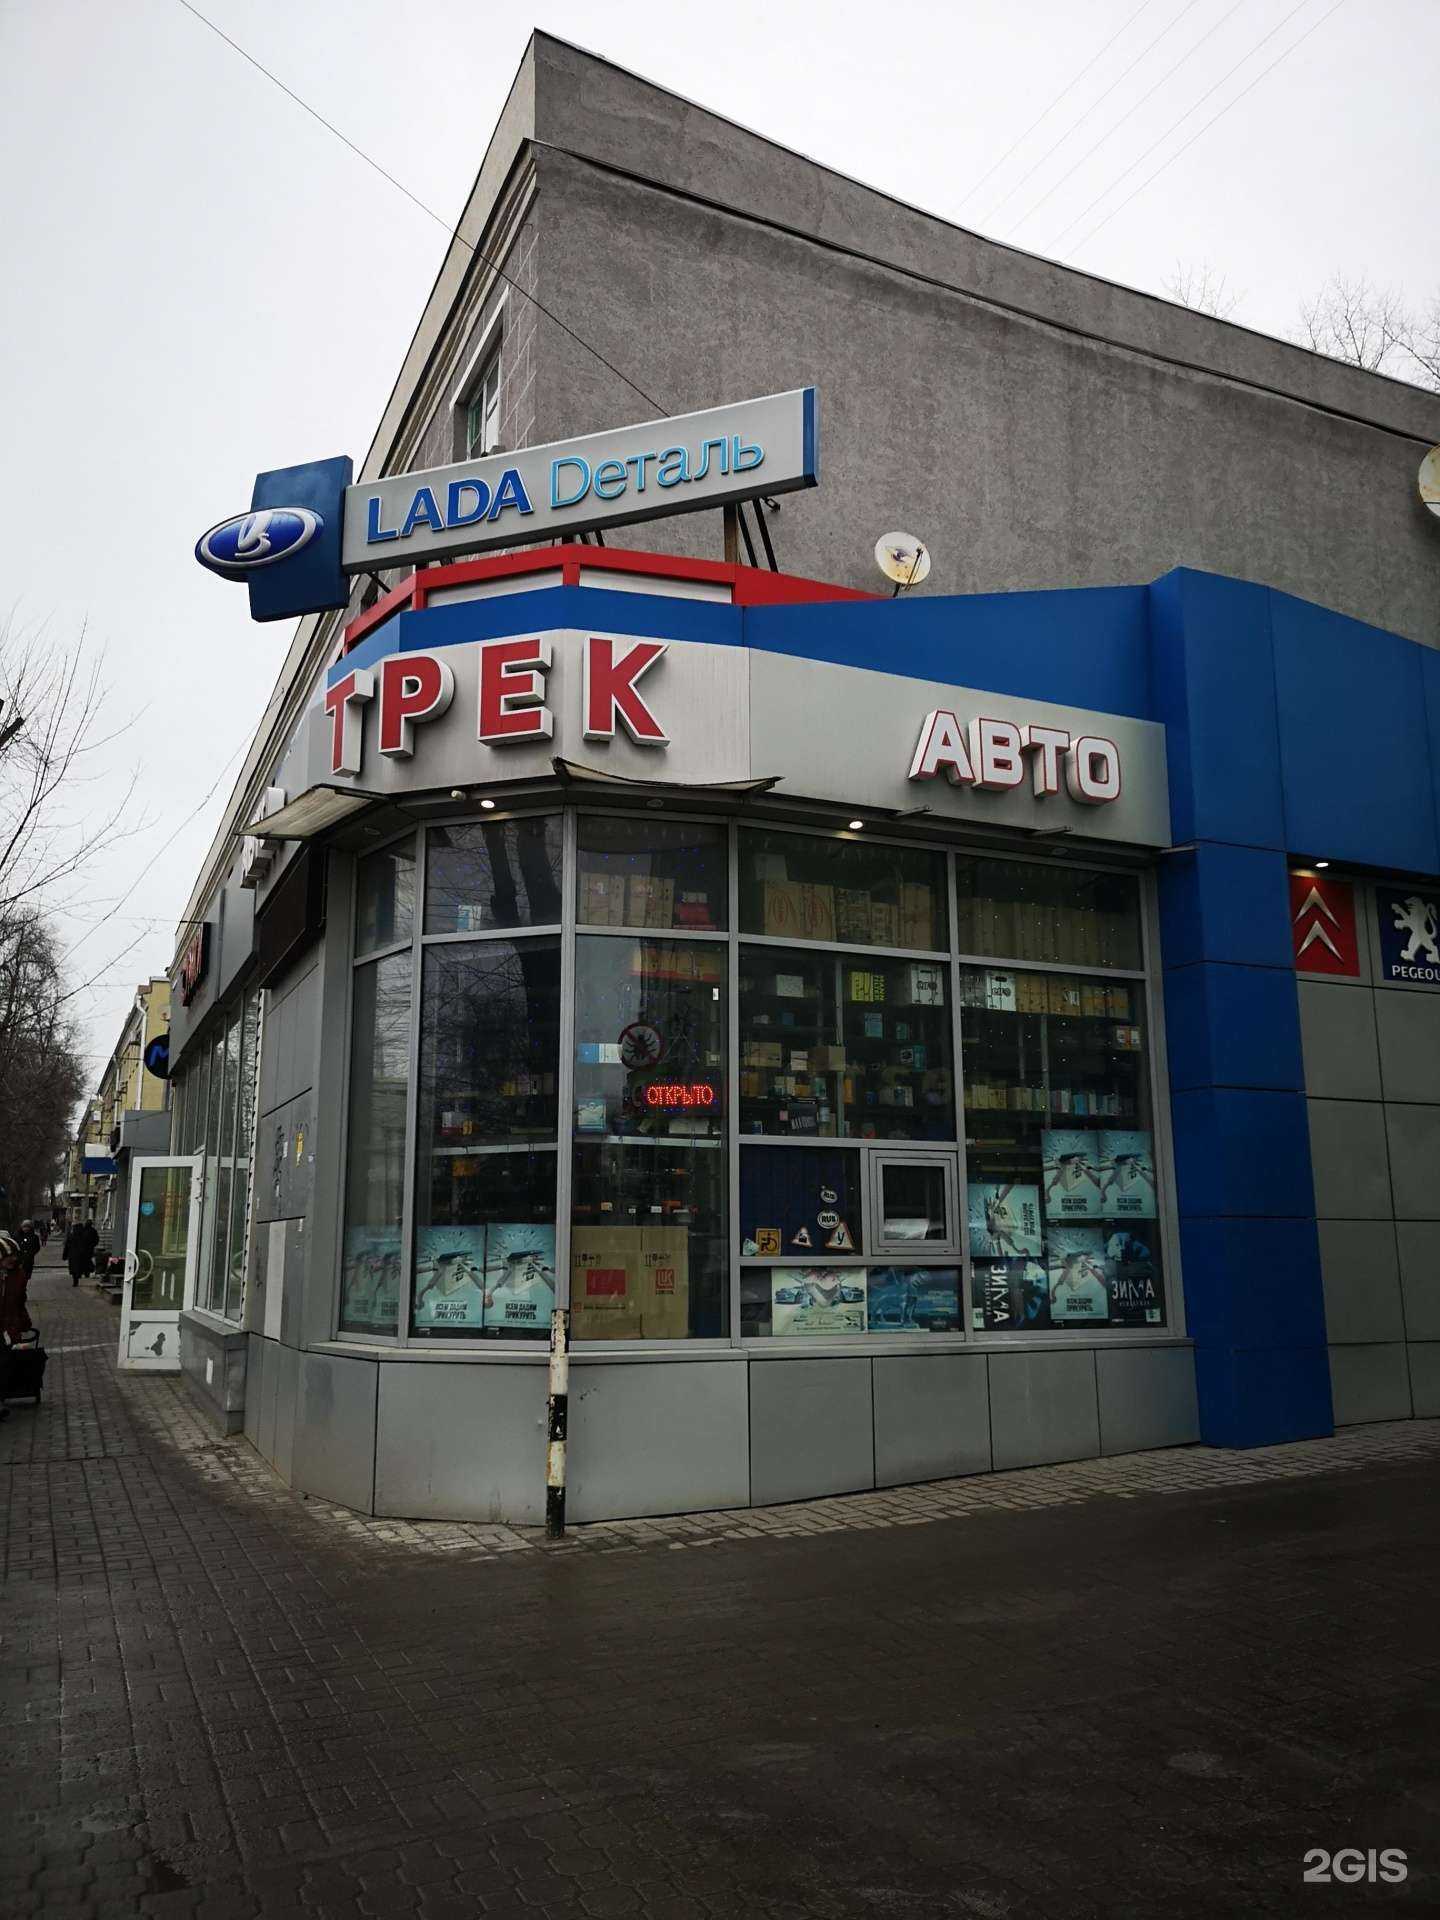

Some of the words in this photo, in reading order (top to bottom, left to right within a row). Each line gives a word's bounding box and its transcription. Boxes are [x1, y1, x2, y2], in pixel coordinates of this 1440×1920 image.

[367, 468, 533, 544] LADA
[325, 636, 671, 777] ТРЕК
[908, 709, 1122, 806] АВТО
[647, 1085, 714, 1105] ОТКРЫТО
